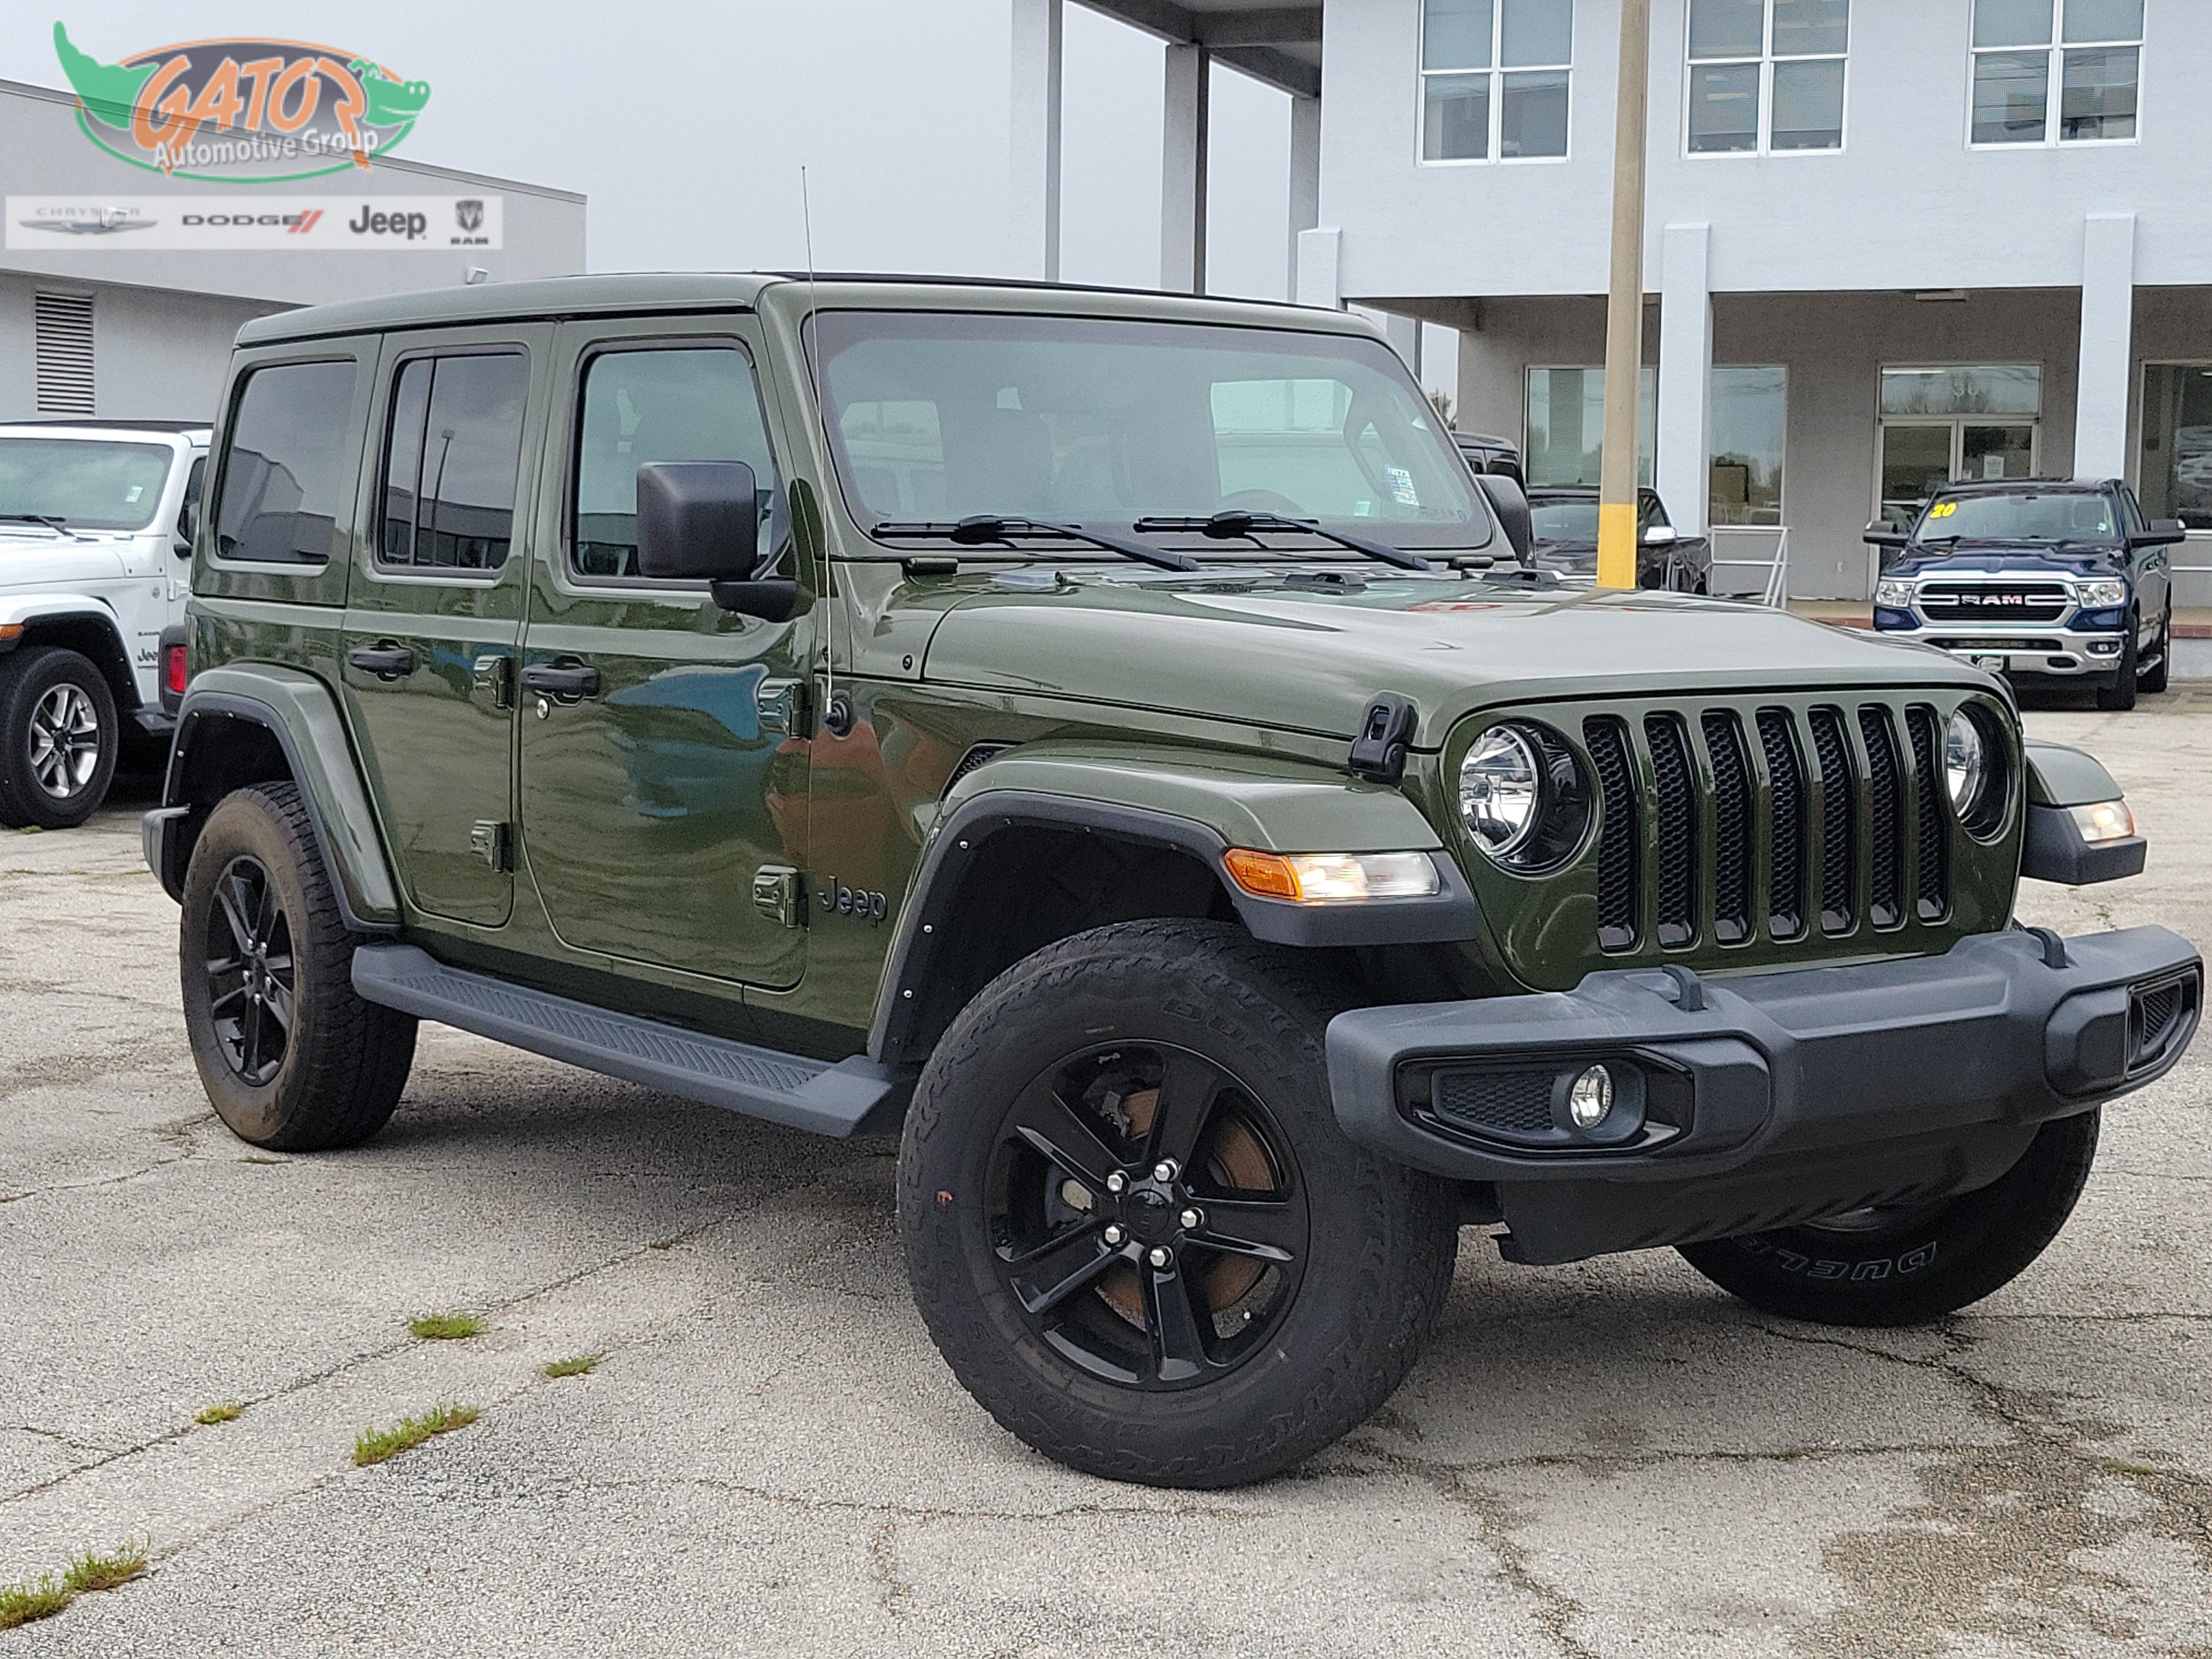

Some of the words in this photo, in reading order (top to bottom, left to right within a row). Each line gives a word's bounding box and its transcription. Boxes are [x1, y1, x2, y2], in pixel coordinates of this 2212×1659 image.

[1929, 502, 1957, 518] 20
[1961, 594, 2023, 606] RAM
[818, 875, 888, 928] Jeep
